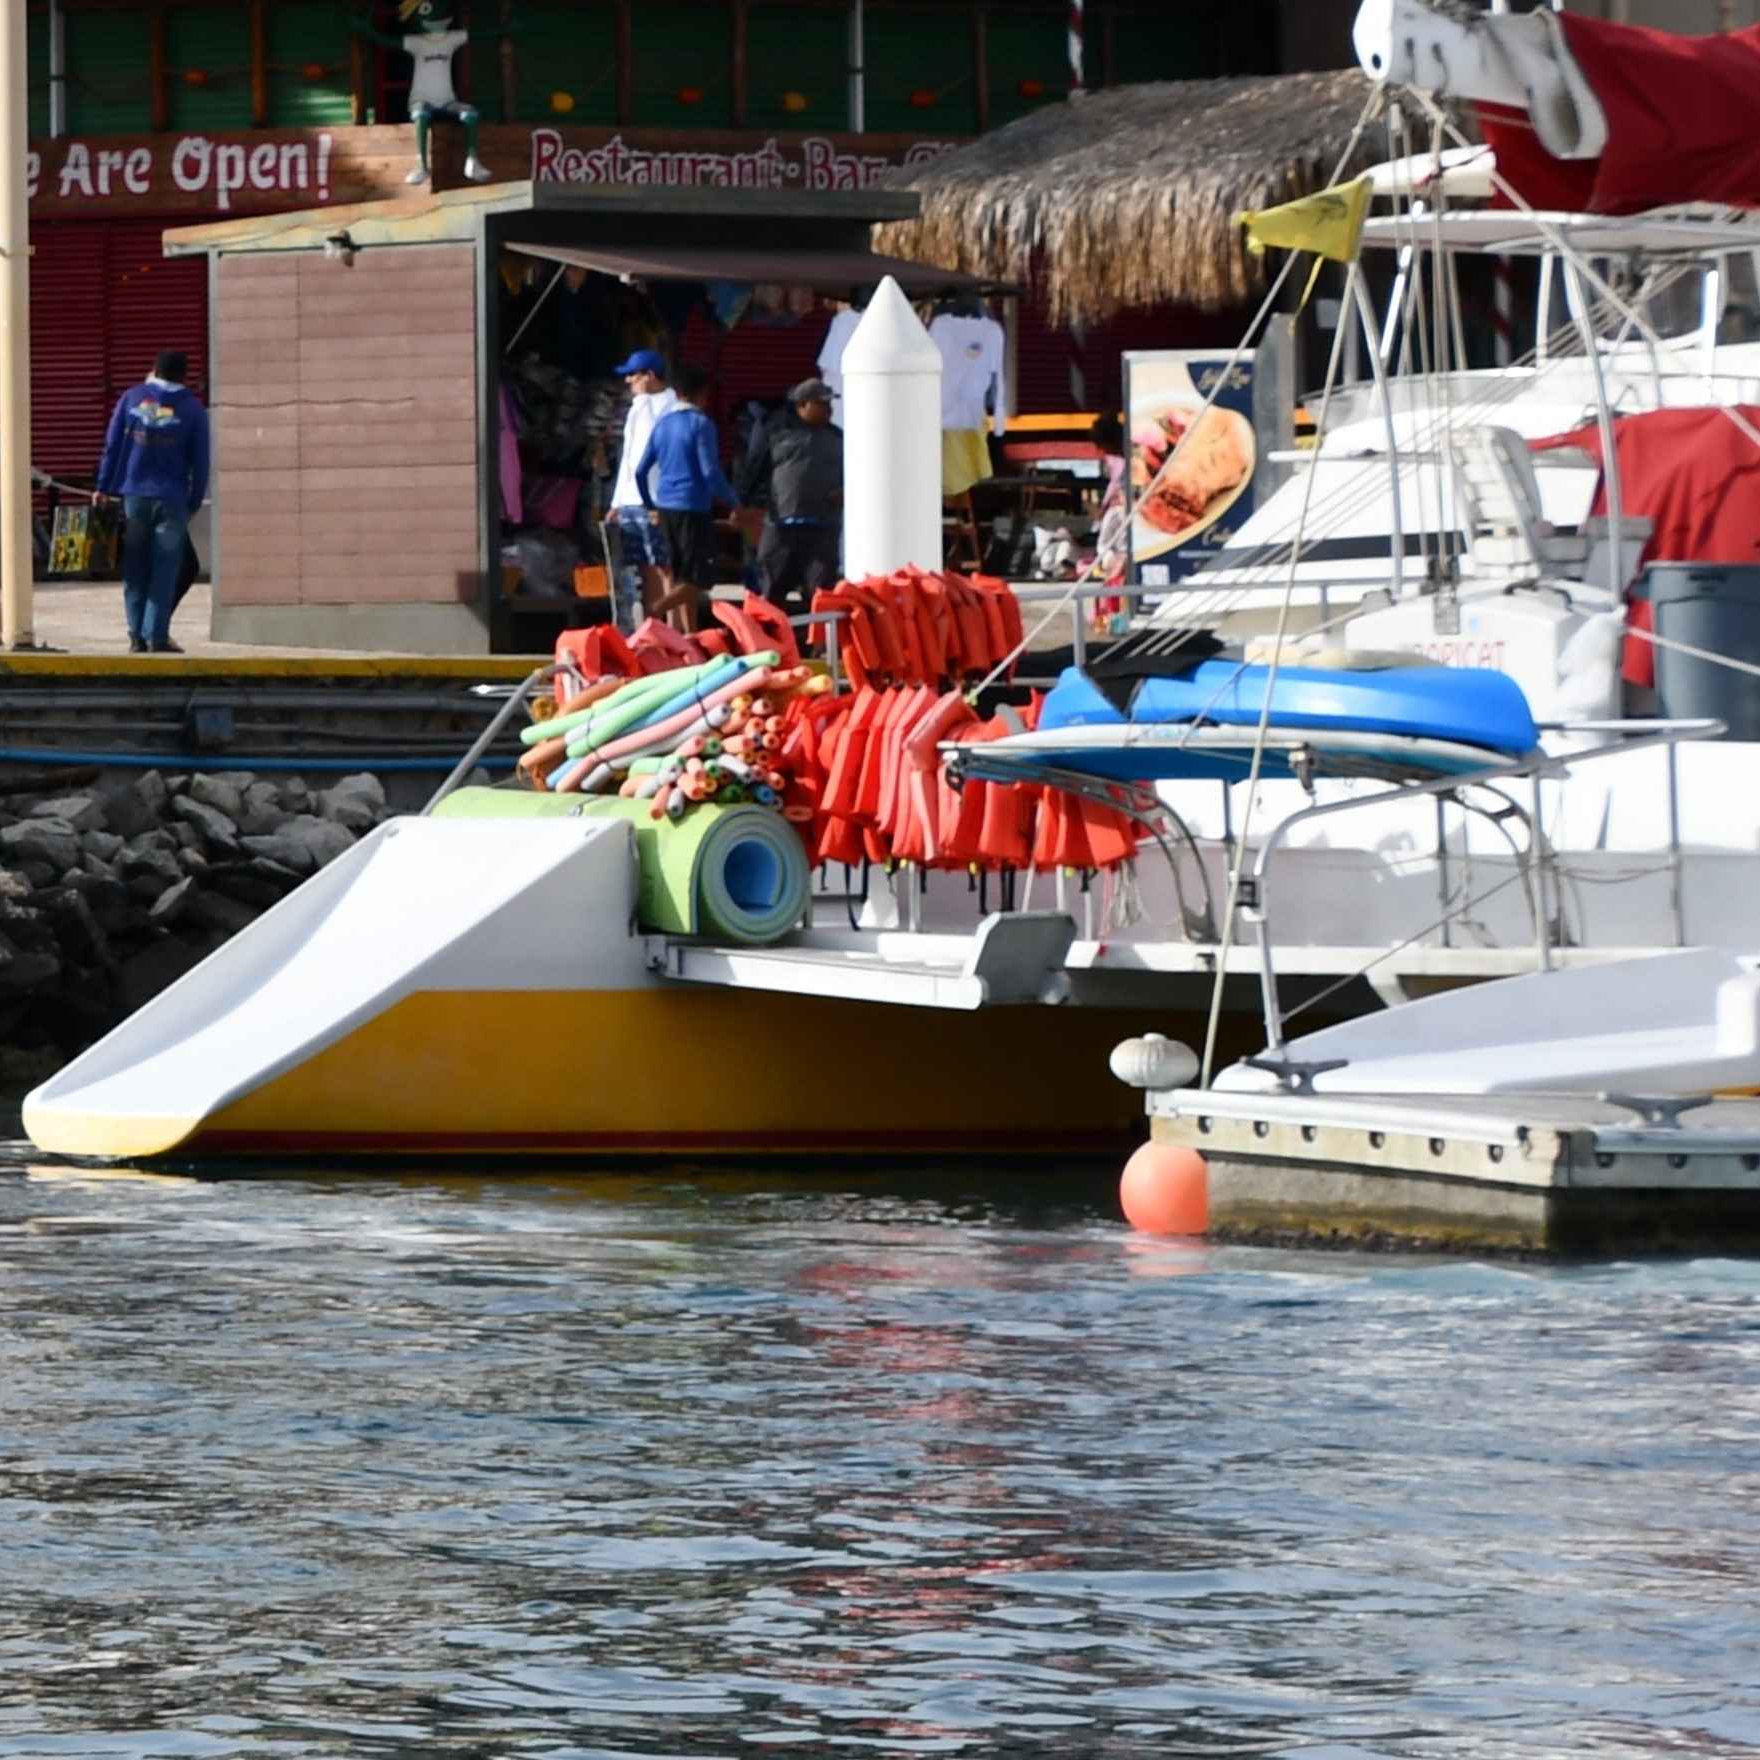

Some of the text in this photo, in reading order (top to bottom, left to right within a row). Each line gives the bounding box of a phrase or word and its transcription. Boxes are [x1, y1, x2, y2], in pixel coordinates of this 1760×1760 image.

[58, 141, 152, 197] Are
[171, 133, 334, 210] Open!
[530, 127, 786, 191] Restaurant
[804, 136, 889, 191] Bar
